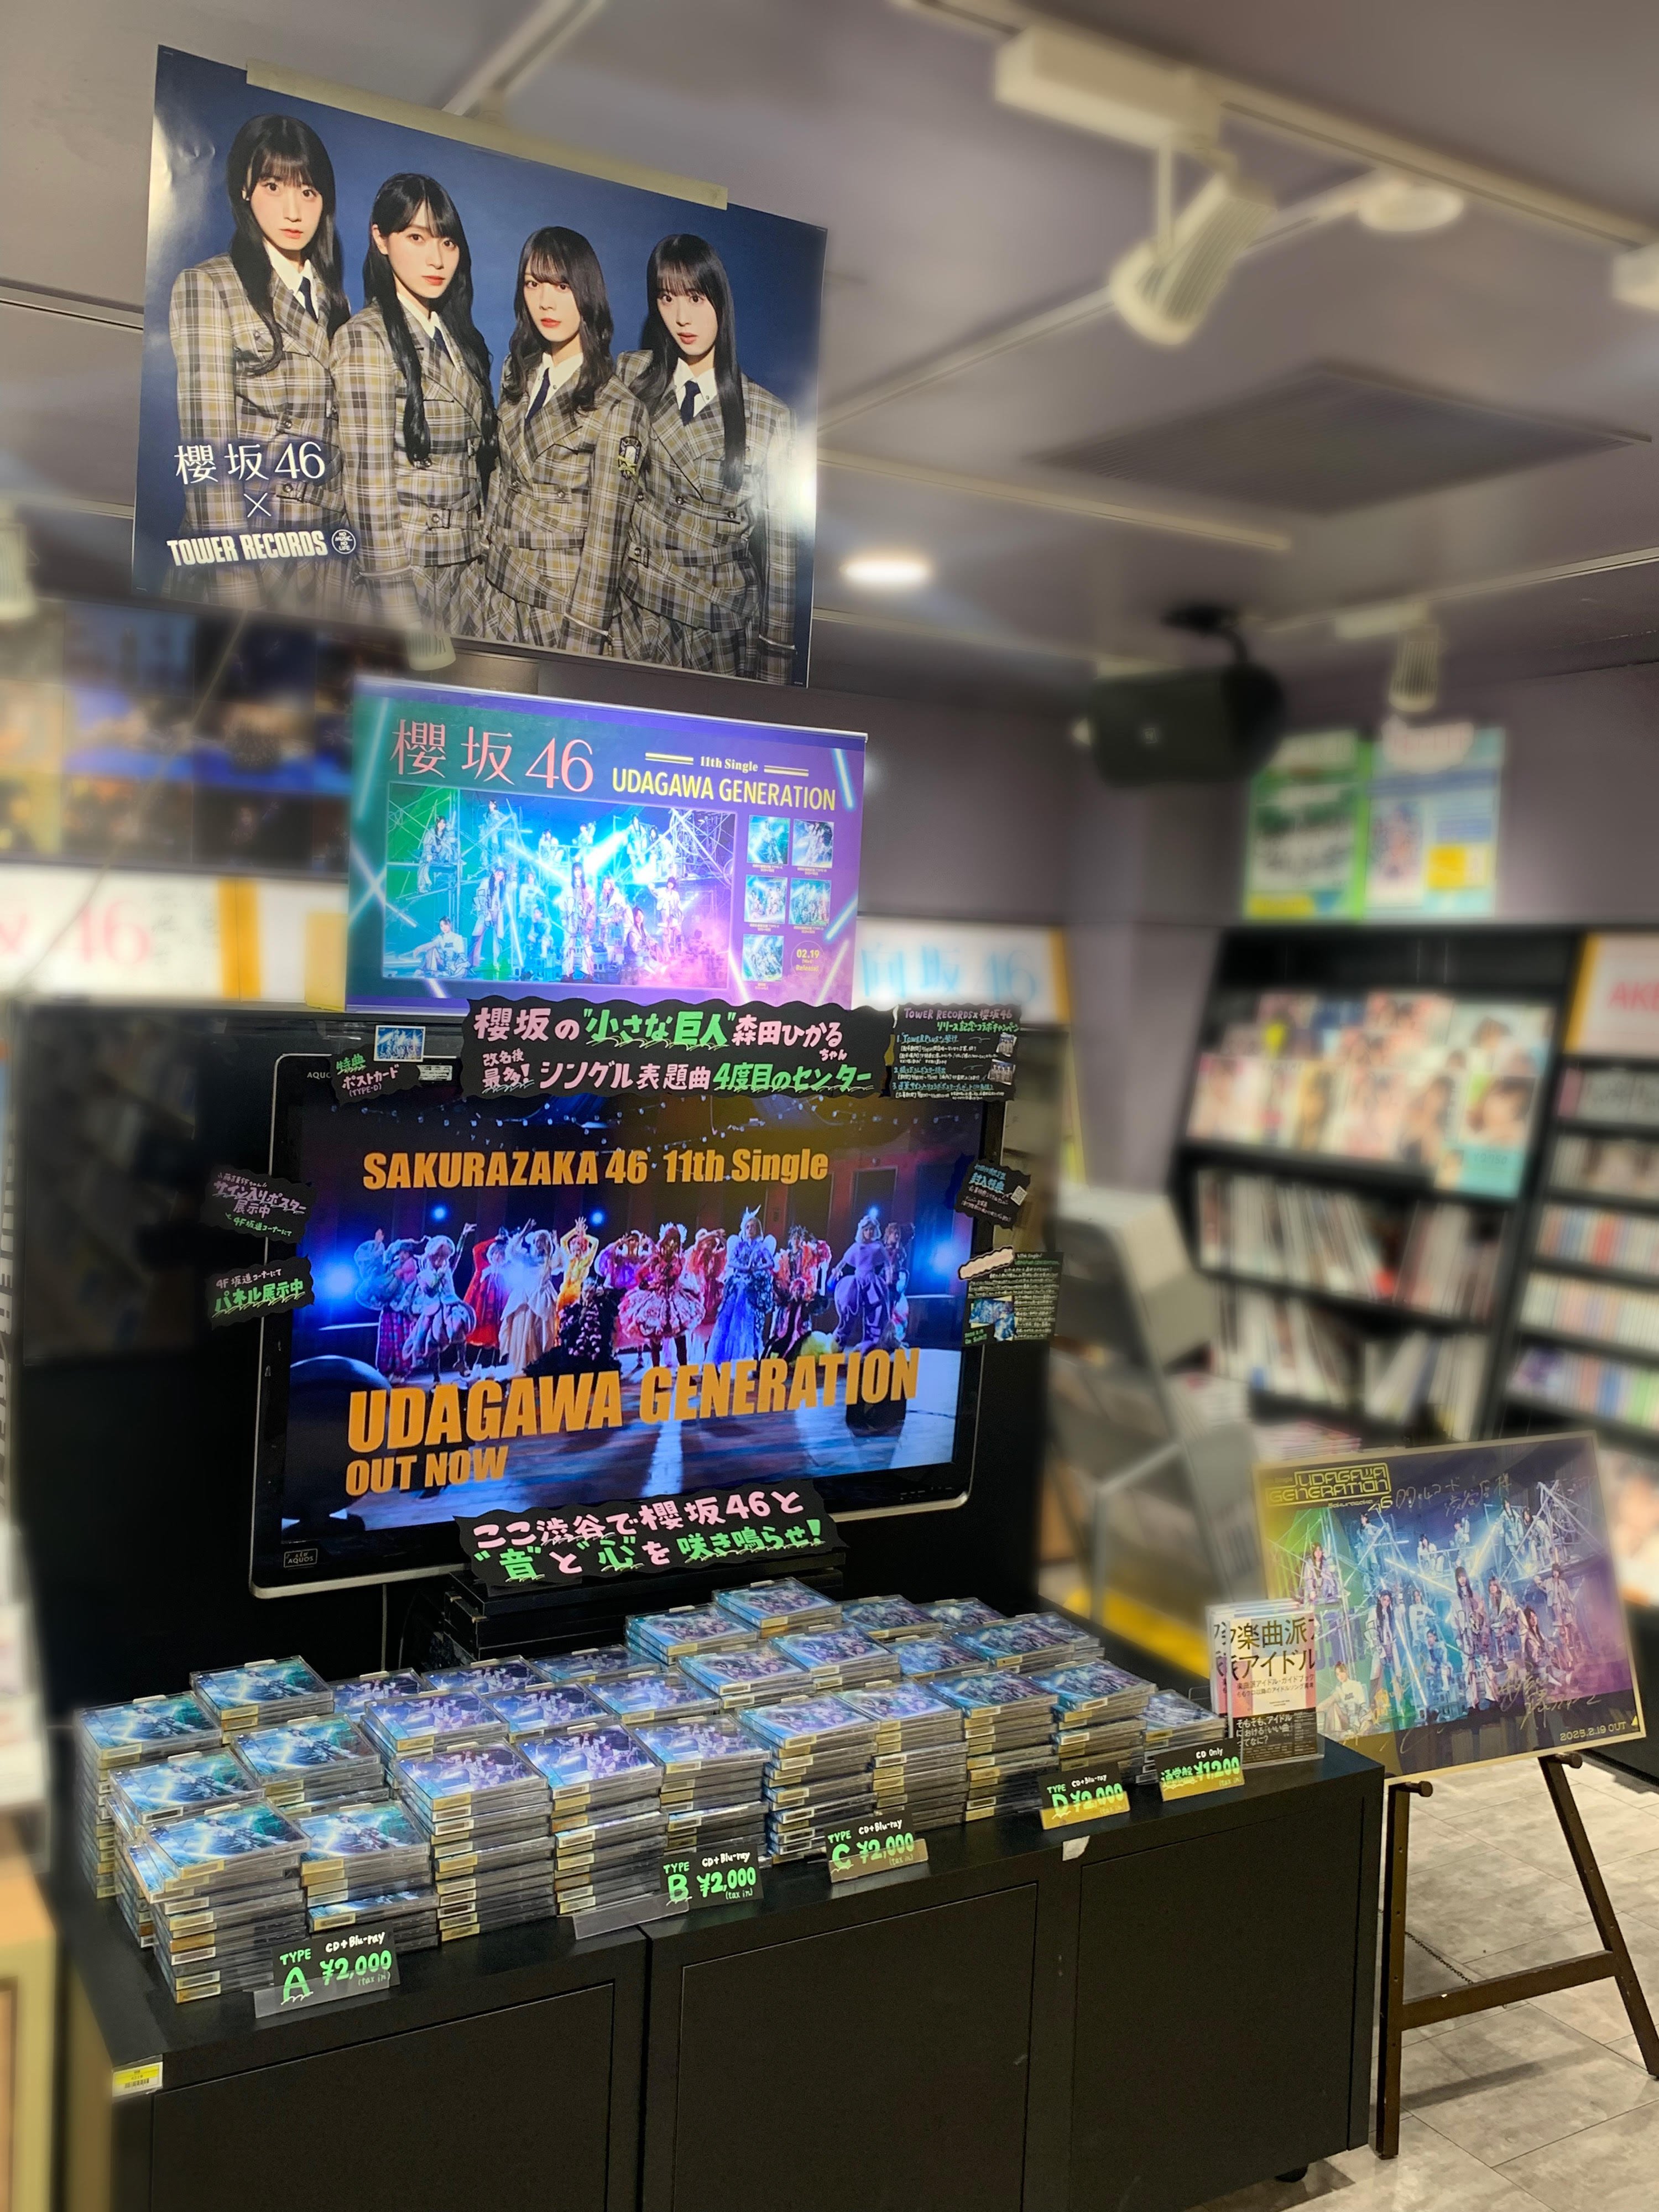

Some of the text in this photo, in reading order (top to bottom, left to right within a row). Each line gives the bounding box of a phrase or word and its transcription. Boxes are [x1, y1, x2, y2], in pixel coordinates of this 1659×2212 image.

[174, 442, 325, 485] 櫻坂46
[166, 530, 328, 566] TOWER RECORDS
[389, 719, 594, 792] 櫻坂46
[700, 756, 759, 774] 11th Single
[612, 767, 836, 811] UDAGAWA GENERATION
[796, 948, 820, 959] 02.19
[904, 1008, 933, 1020] TOWER
[336, 1053, 366, 1071] 特典
[482, 1048, 525, 1067] 改名後
[819, 1049, 847, 1062] ちゃん
[342, 1064, 399, 1089] ポストカード
[349, 1084, 382, 1097] (TYPE-D)
[363, 1147, 829, 1190] SAKURAZAKA 46 11th Single
[213, 1180, 306, 1210] サイン入りポスター
[233, 1199, 270, 1218] 展示中
[215, 1279, 304, 1312] パネル展示中
[347, 1348, 921, 1453] UDAGAWA GENERATION
[345, 1446, 509, 1495] OUT NOW
[1298, 1467, 1386, 1486] UDAGAWA
[473, 1491, 804, 1547] ここ渋谷で櫻坂46と
[288, 1556, 314, 1564] AQUOS
[1559, 1721, 1626, 1741] 2025.2.19 OUT
[1196, 1747, 1223, 1759] CD Only
[1047, 1783, 1066, 1793] TYPE
[1071, 1774, 1107, 1788] CD+Blu-ray
[1052, 1793, 1068, 1815] D
[828, 1830, 852, 1843] TYPE
[858, 1819, 902, 1835] CD+Blu-ray
[702, 1851, 750, 1867] CD+Blu-ray
[831, 1832, 915, 1870] C ¥2,000
[664, 1861, 690, 1872] TYPE
[889, 1856, 904, 1866] (tax
[667, 1866, 757, 1901] B ¥2,000
[725, 1888, 753, 1900] (tax in)
[325, 1932, 385, 1953] CD+Blu-ray
[279, 1948, 311, 1965] TYPE
[283, 1950, 392, 2002] A ¥2,000
[358, 1971, 390, 1986] (tax in)
